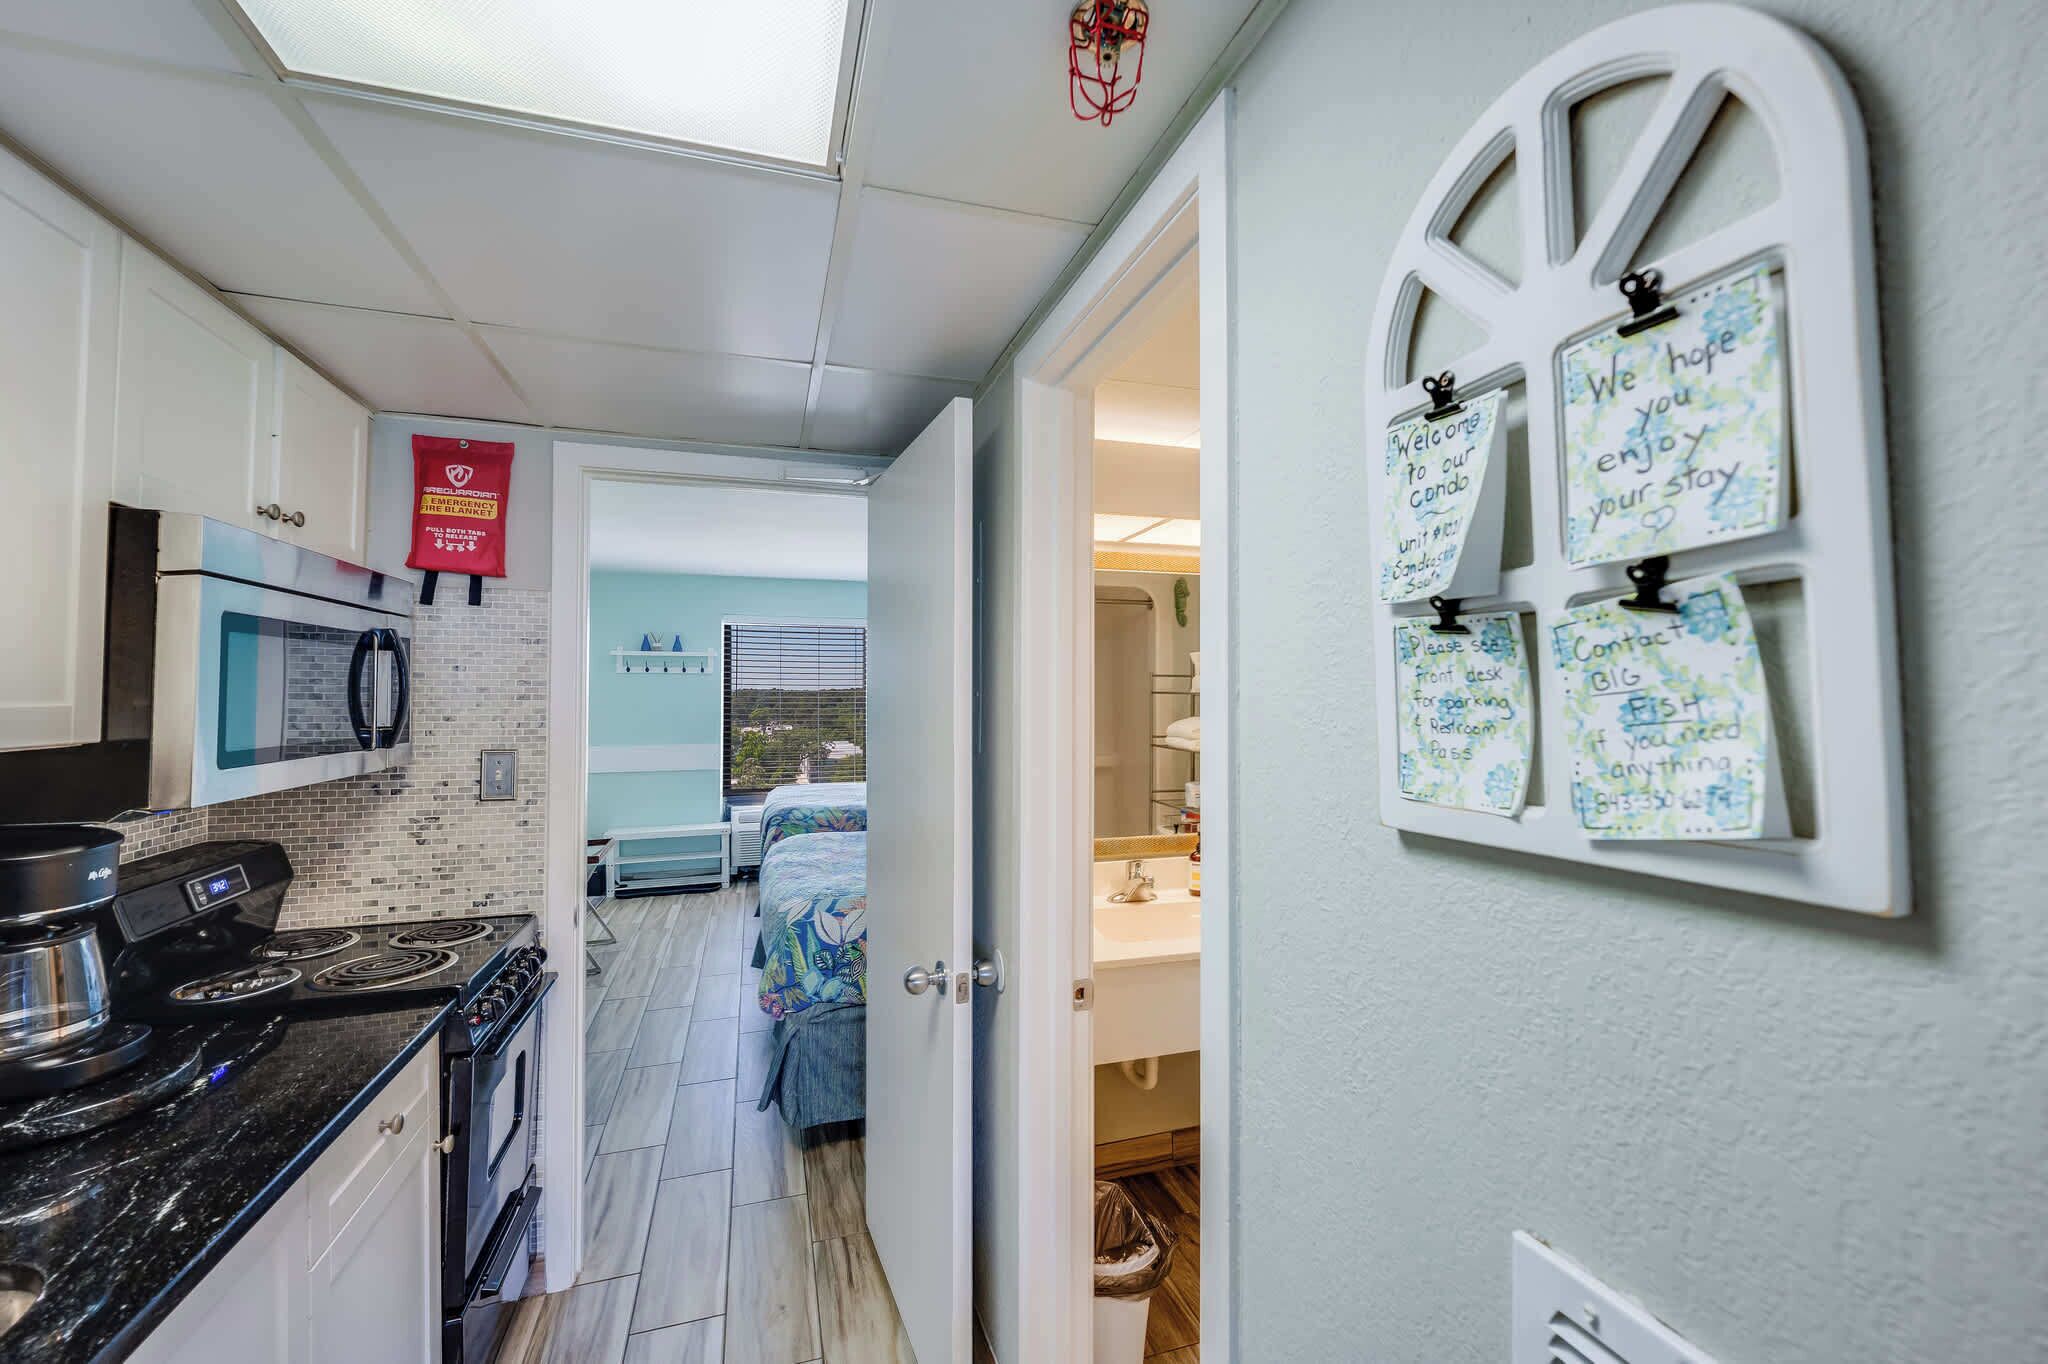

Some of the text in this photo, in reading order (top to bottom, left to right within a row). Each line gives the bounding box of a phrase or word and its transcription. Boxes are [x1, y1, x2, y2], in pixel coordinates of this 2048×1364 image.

[1587, 331, 1736, 404] We hope
[1635, 388, 1691, 436] you
[1392, 412, 1481, 457] Welcome
[1597, 425, 1707, 474] enjoy
[1407, 447, 1476, 485] to our
[421, 504, 493, 517] FIRE BLANKET
[431, 498, 495, 509] EMERGENCY
[1590, 462, 1740, 533] your stay
[445, 533, 478, 541] RELEASE
[468, 529, 486, 537] TABS
[1409, 636, 1503, 657] Please see
[1573, 618, 1685, 662] Contact
[1415, 664, 1503, 684] front desk
[1591, 668, 1641, 691] BIG
[1414, 690, 1515, 720] for parking
[1628, 693, 1702, 721] FISH
[1625, 735, 1669, 760] you
[1682, 712, 1740, 743] need
